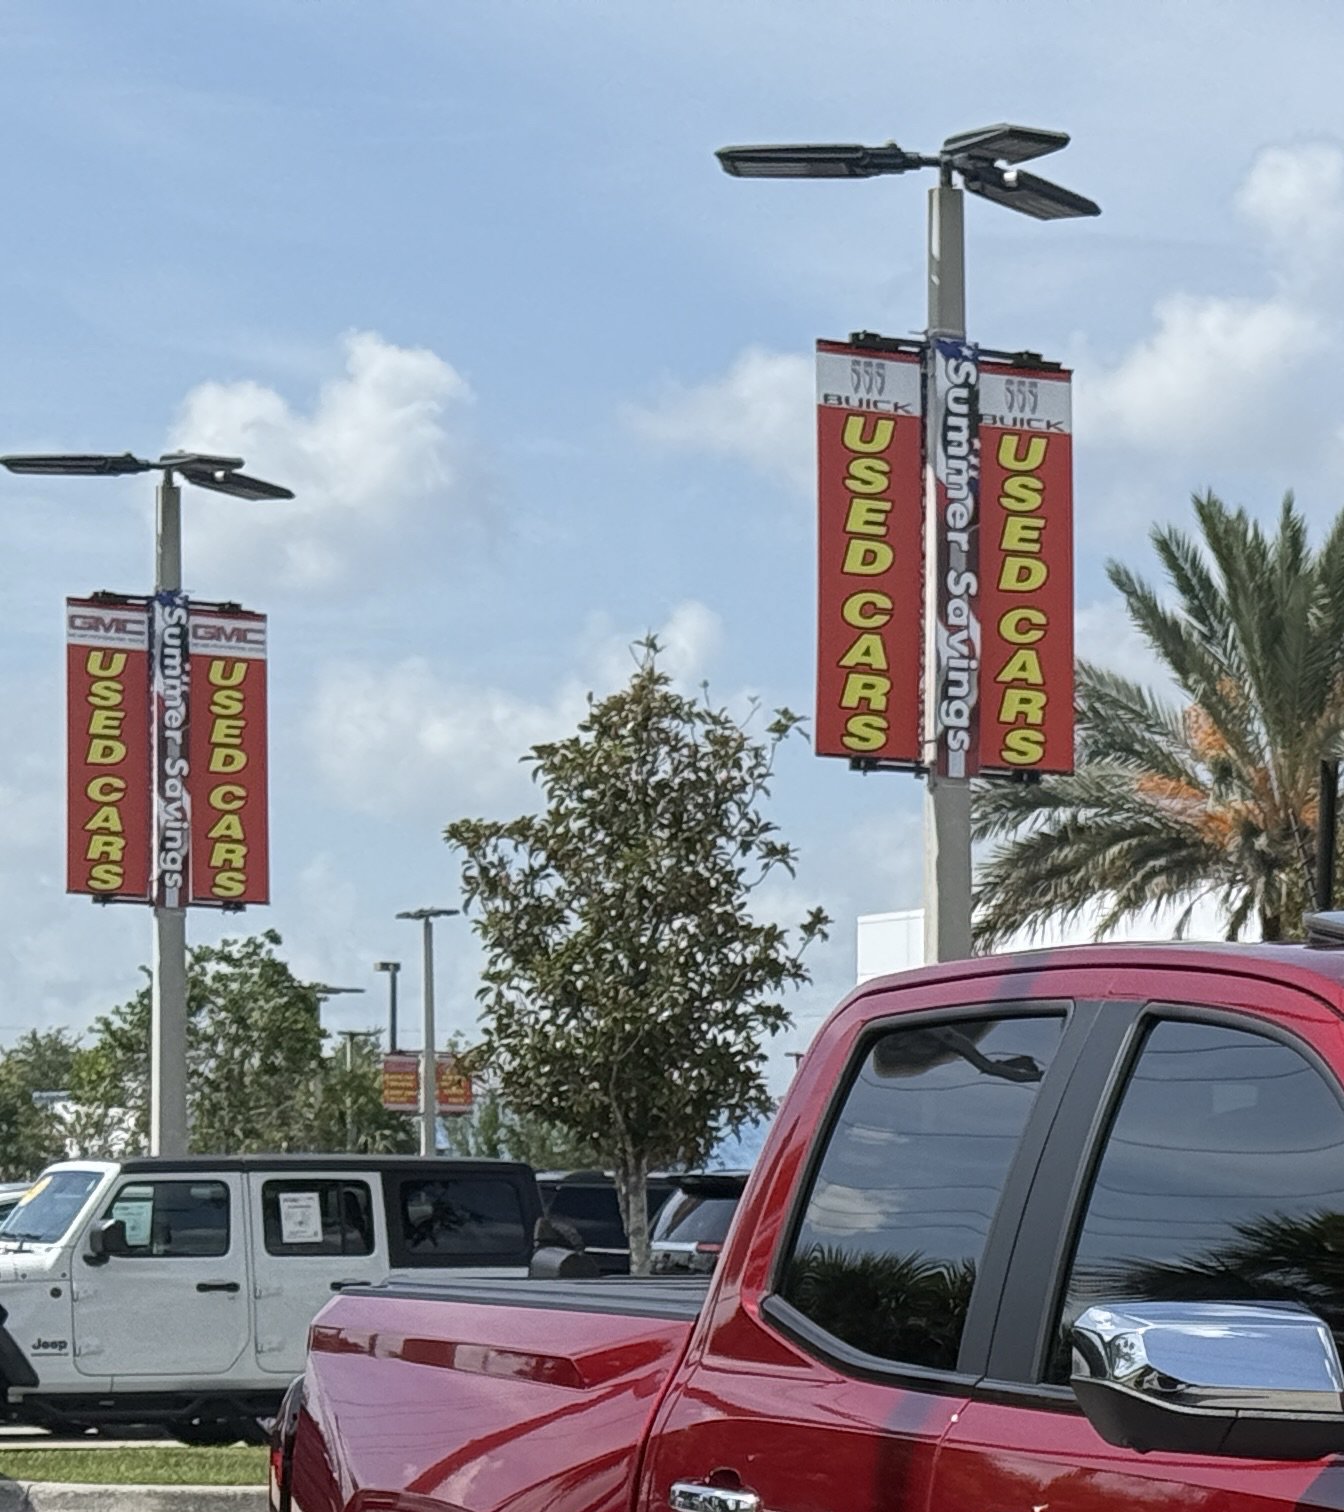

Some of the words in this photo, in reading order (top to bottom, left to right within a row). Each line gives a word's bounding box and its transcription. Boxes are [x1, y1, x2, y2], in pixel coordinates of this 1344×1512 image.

[823, 393, 913, 413] BUICK
[945, 358, 978, 552] Summer
[980, 414, 1065, 432] BUICK
[841, 416, 895, 575] USED
[997, 435, 1048, 592] USED
[70, 615, 146, 635] GMC
[163, 605, 188, 745] Summer
[192, 624, 265, 645] GMC
[839, 591, 894, 751] CARS
[939, 569, 978, 752] Savings
[85, 651, 128, 765] USED
[208, 660, 248, 773] USED
[996, 608, 1048, 765] CARS
[84, 776, 127, 890] CARS
[160, 758, 189, 889] Savings
[207, 785, 248, 898] CARS
[31, 1337, 68, 1351] Jeep
